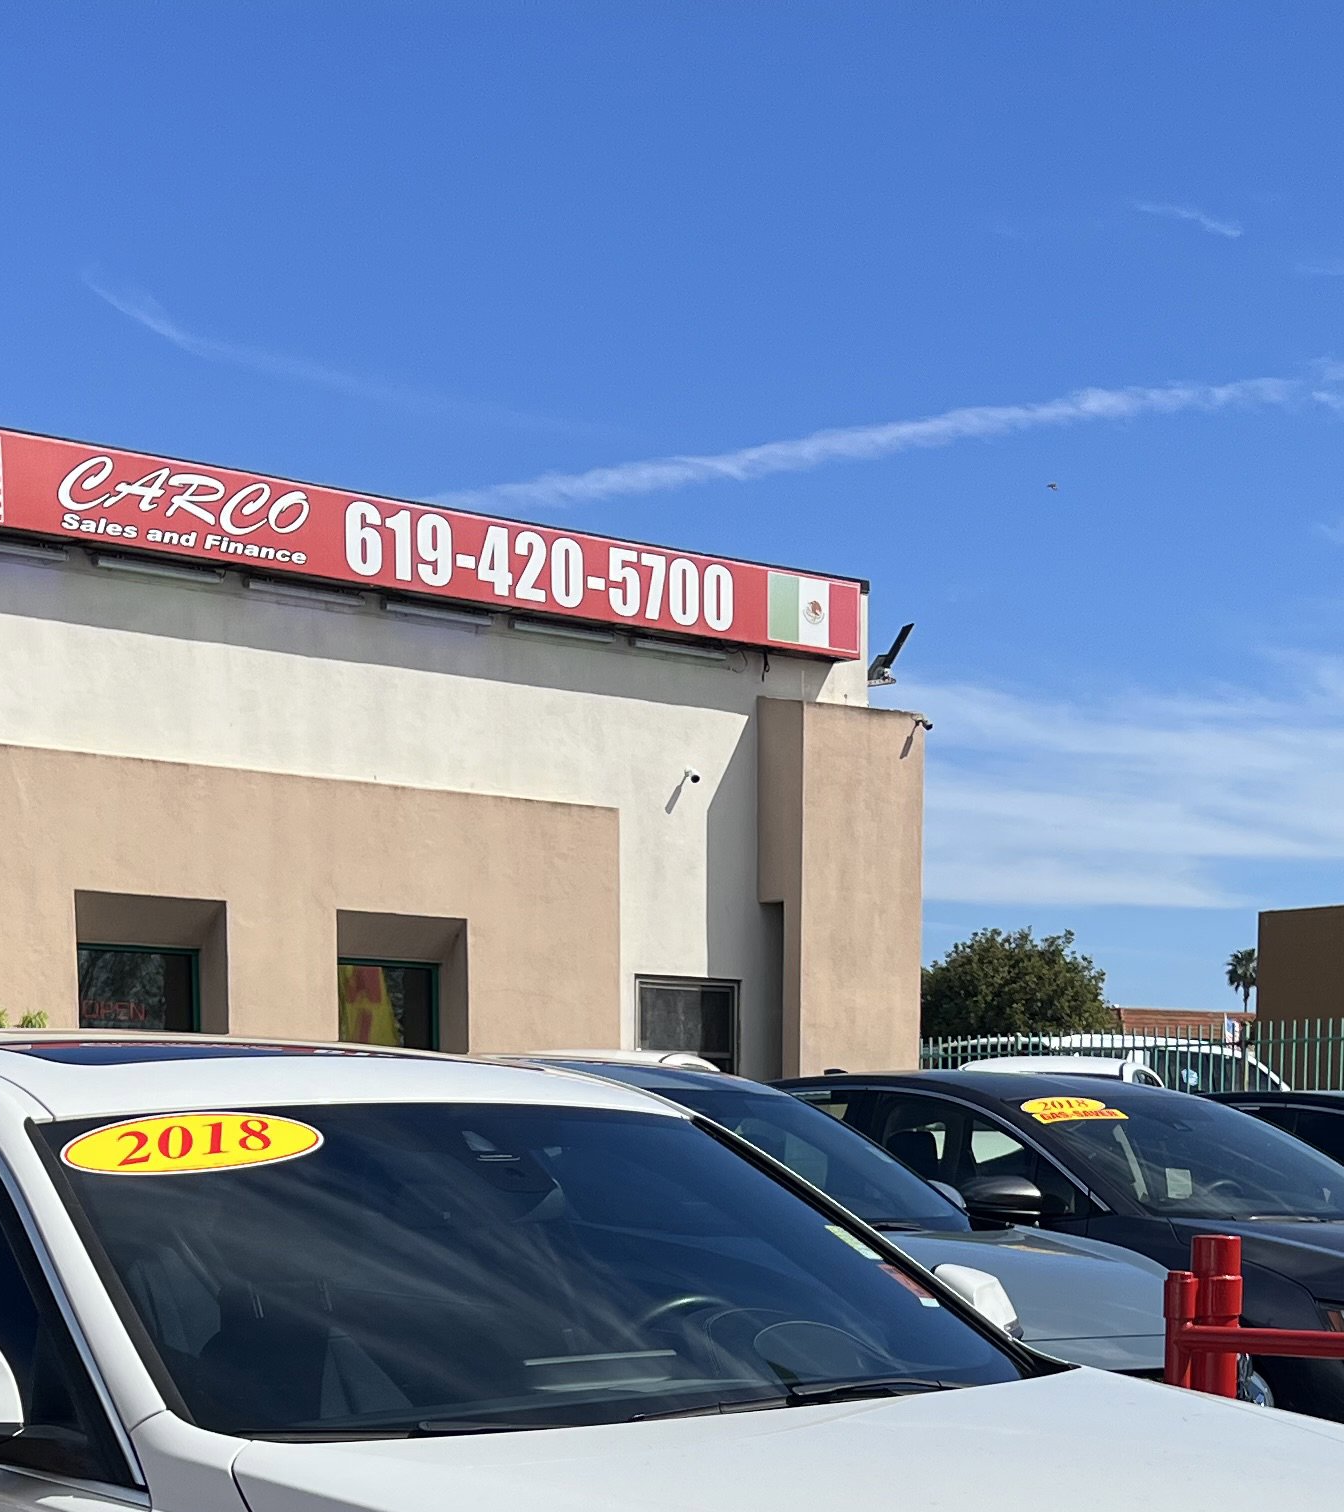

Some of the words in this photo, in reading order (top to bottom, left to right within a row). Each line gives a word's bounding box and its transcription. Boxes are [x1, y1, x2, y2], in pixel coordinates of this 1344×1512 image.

[56, 454, 311, 537] CARCO
[60, 512, 139, 540] Sales
[146, 528, 198, 548] and
[203, 533, 309, 566] Finance
[344, 500, 736, 632] 619-420-5700
[82, 1000, 147, 1021] OPEN
[1037, 1099, 1089, 1112] 2018
[116, 1118, 273, 1167] 2018
